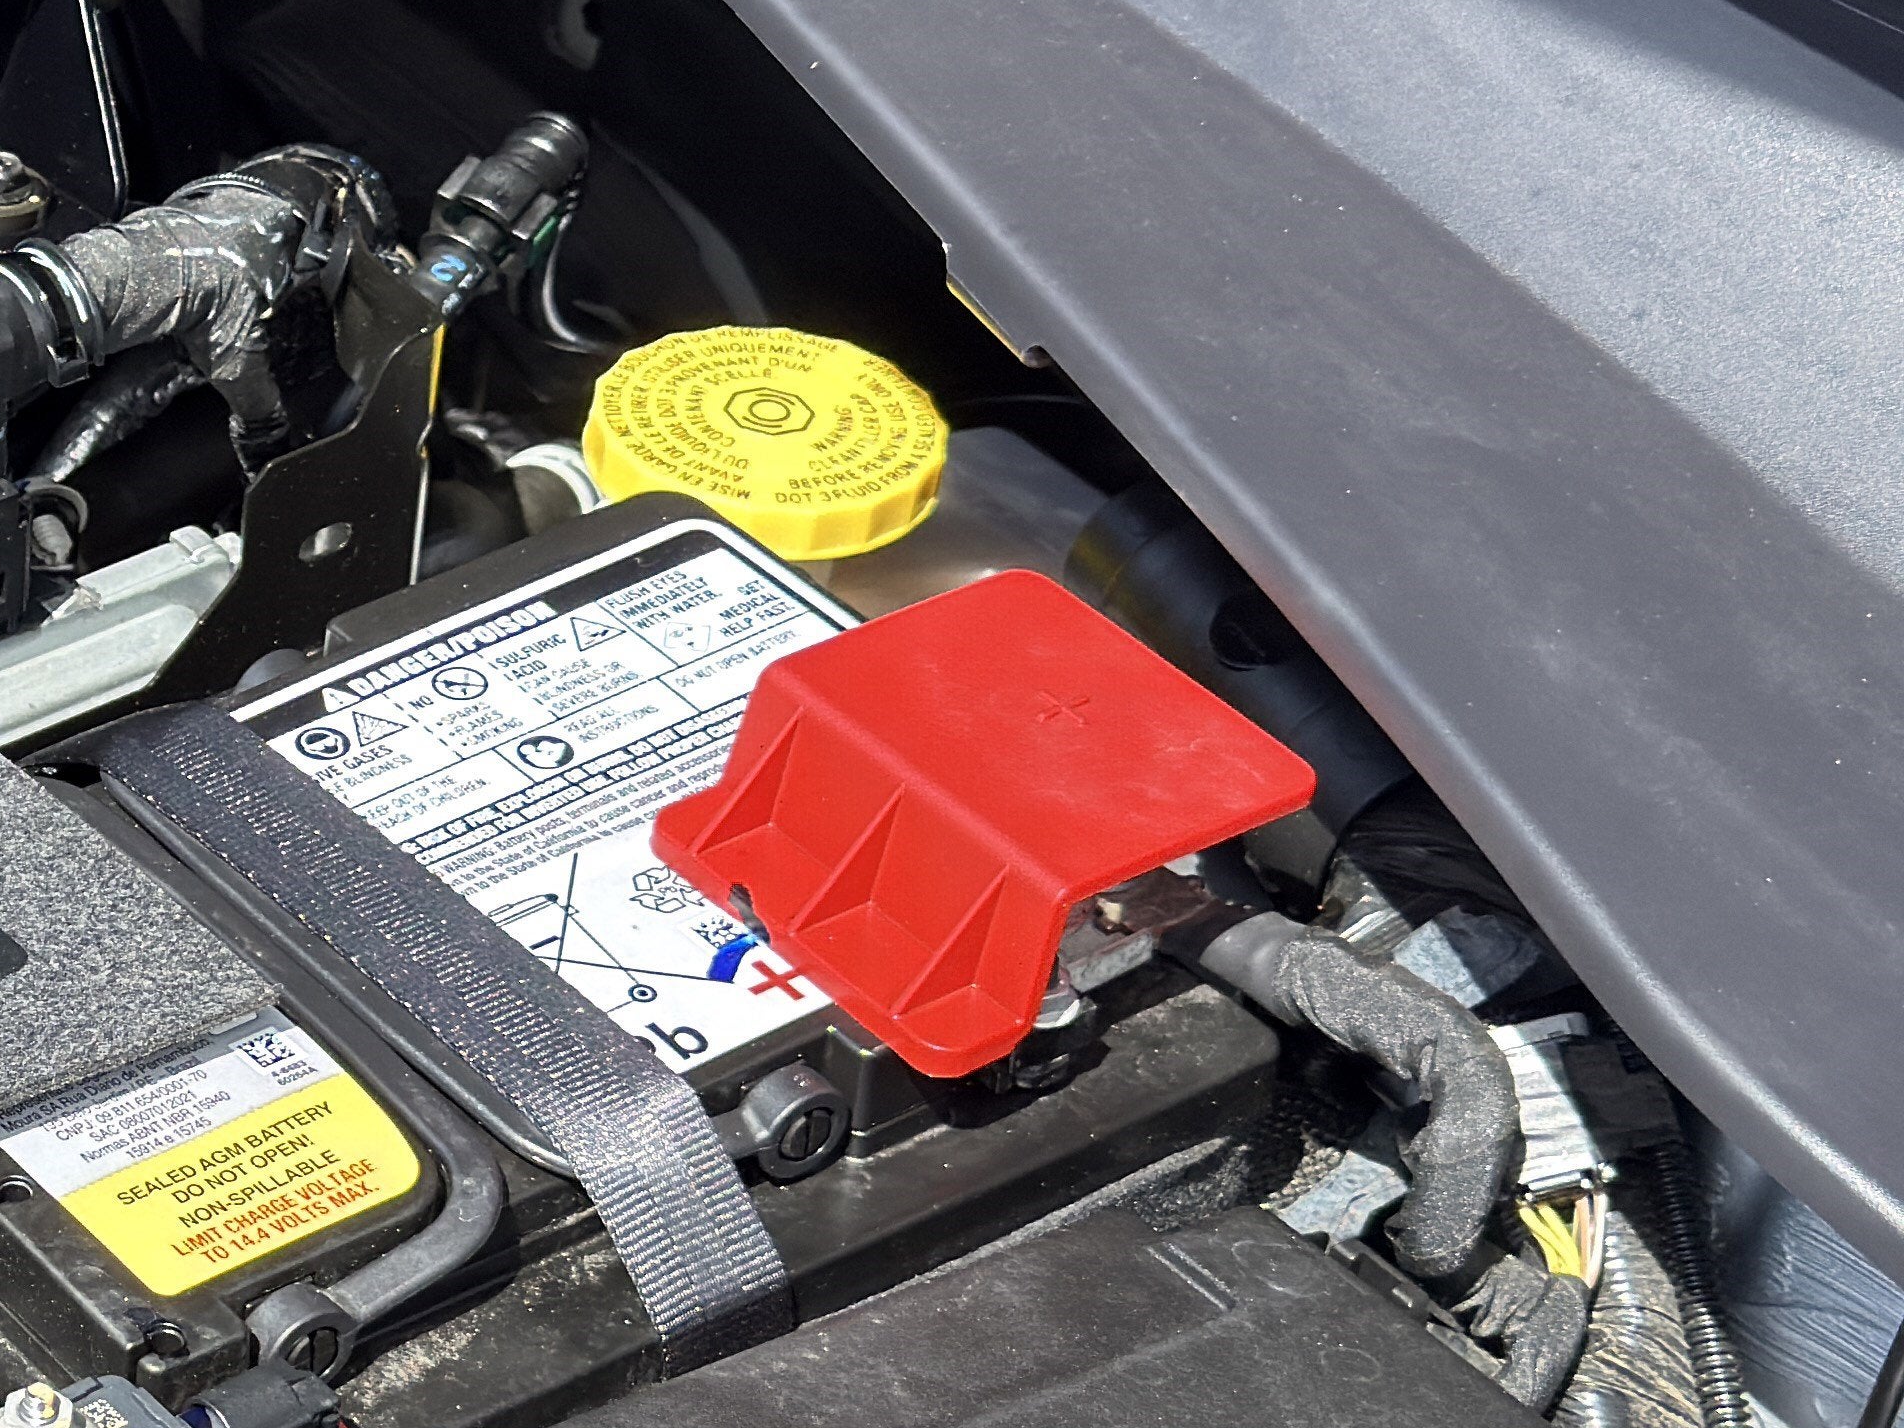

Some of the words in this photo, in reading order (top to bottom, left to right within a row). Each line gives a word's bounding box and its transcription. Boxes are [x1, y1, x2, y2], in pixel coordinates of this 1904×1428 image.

[677, 471, 703, 486] EN
[709, 481, 751, 499] MISE
[775, 492, 812, 503] DOT
[819, 491, 831, 502] 3
[831, 481, 882, 499] FLUID
[879, 460, 919, 486] FROM
[789, 469, 862, 490] BEFORE
[605, 587, 650, 608] FLUSH
[650, 571, 687, 589] EYES
[620, 577, 707, 619] IMMEDIATELY
[719, 594, 780, 620] MEDICAL
[636, 610, 671, 628] WITH
[720, 618, 753, 637] HELP
[346, 601, 559, 697] DANGER/POISON
[496, 634, 566, 667] SULFURIC
[512, 660, 547, 679] ACID
[408, 696, 434, 710] NO
[343, 745, 393, 769] GASES
[473, 865, 495, 875] the
[492, 853, 523, 867] State
[522, 846, 536, 855] of
[533, 826, 587, 849] California
[599, 805, 631, 823] cause
[666, 779, 689, 793] and
[493, 830, 537, 851] Battery
[616, 783, 638, 797] and
[637, 769, 676, 788] related
[487, 873, 508, 883] the
[505, 861, 537, 875] State
[547, 835, 601, 857] California
[0, 1112, 42, 1132] Moura
[39, 1102, 63, 1115] SA
[57, 1093, 87, 1107] Rua
[122, 1069, 138, 1081] de
[80, 1139, 129, 1163] Normas
[128, 1121, 163, 1142] ABNT
[162, 1109, 194, 1127] NBR
[89, 1125, 119, 1141] SAC
[117, 1165, 196, 1204] SEALED
[200, 1143, 246, 1171] AGM
[244, 1101, 332, 1148] BATTERY
[171, 1184, 204, 1203] DO
[204, 1163, 247, 1189] NOT
[250, 1134, 314, 1168] OPEN!
[178, 1150, 340, 1228] NON-SPILLABLE
[171, 1227, 222, 1256] LIMIT
[223, 1194, 298, 1233] CHARGE
[295, 1159, 374, 1200] VOLTAGE
[200, 1246, 229, 1262] TO
[230, 1228, 270, 1250] 14.4
[269, 1202, 329, 1232] VOLTS
[327, 1181, 379, 1207] MAX.
